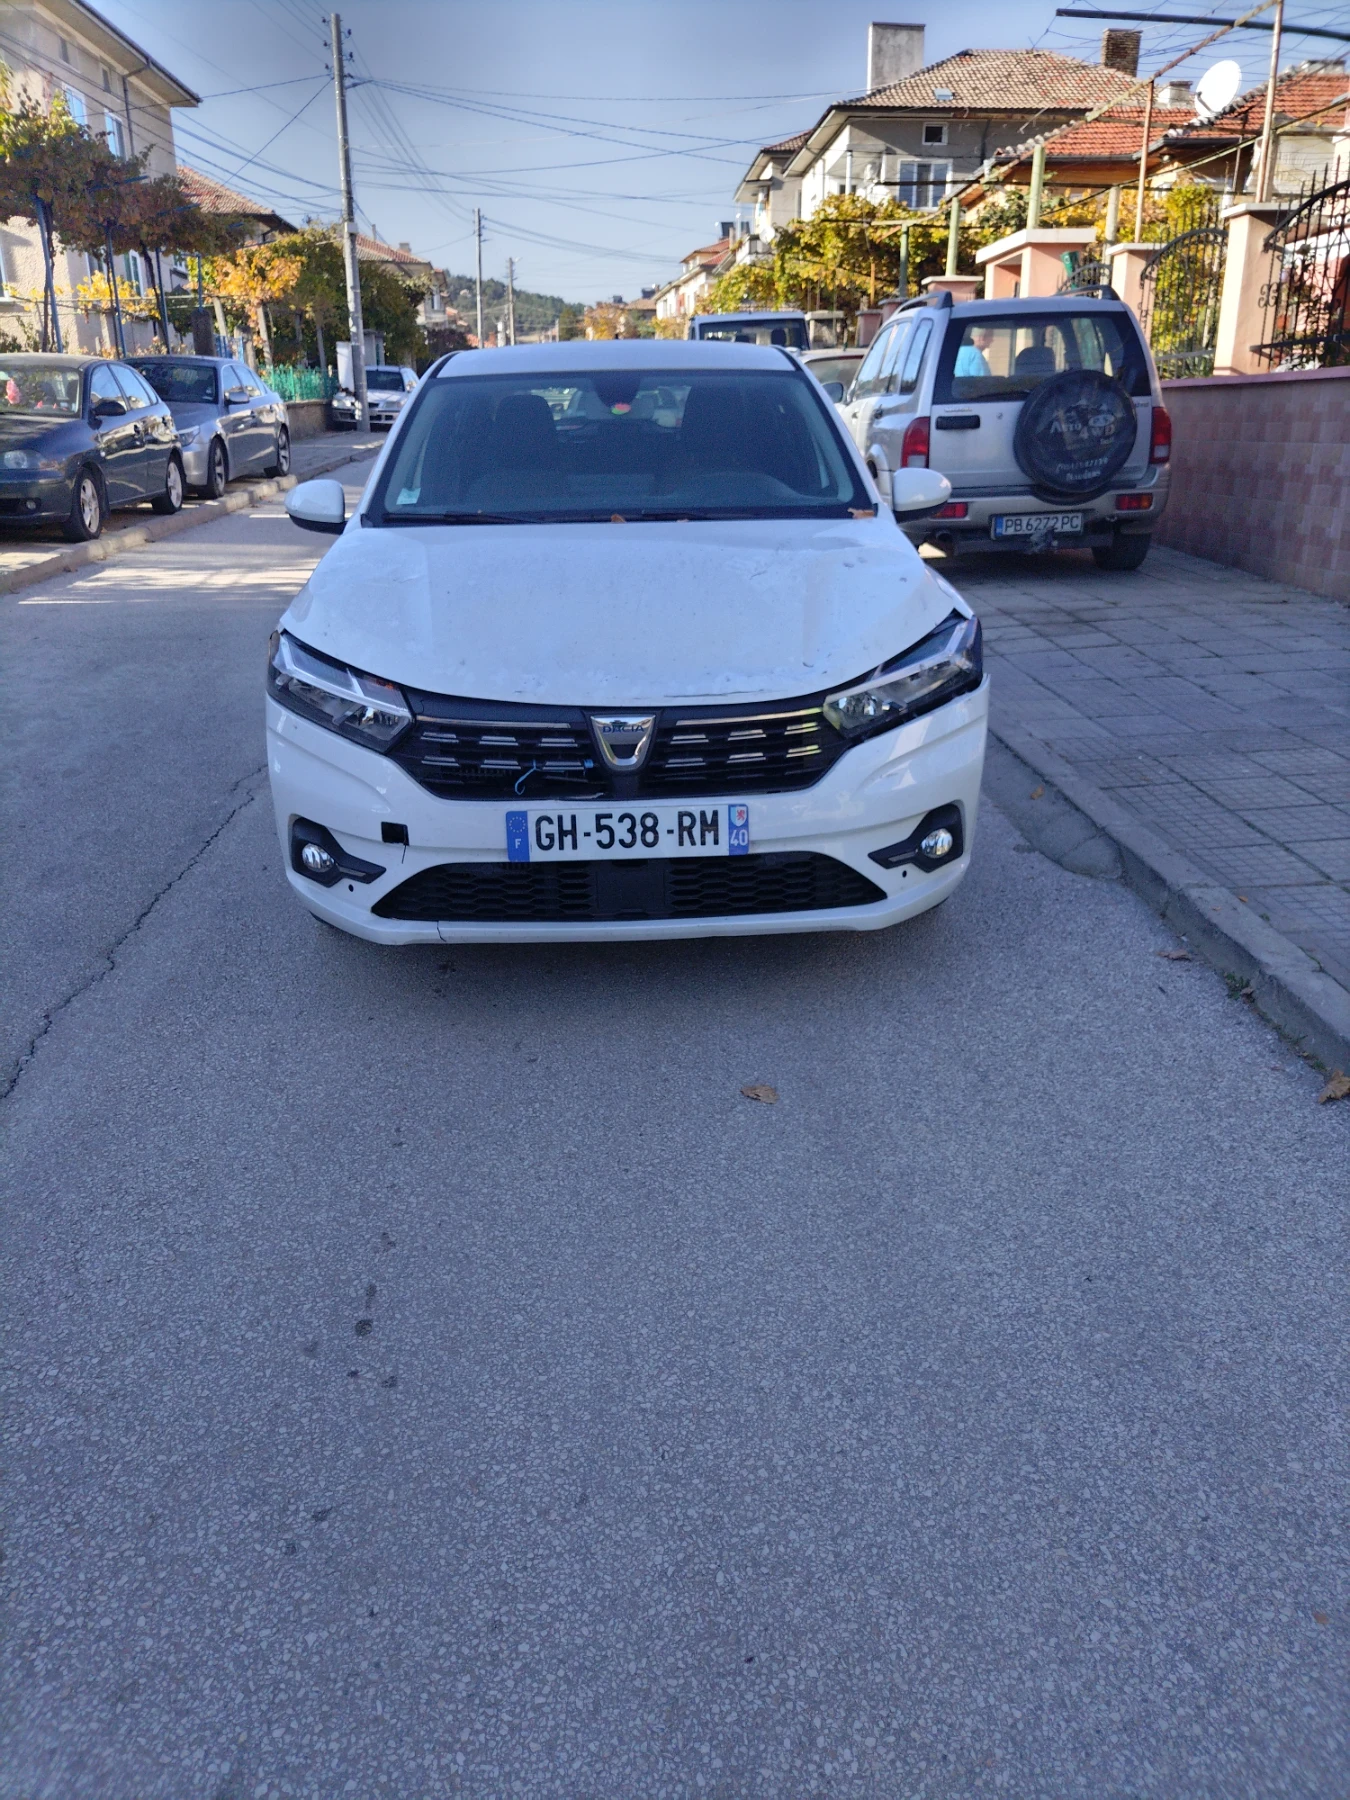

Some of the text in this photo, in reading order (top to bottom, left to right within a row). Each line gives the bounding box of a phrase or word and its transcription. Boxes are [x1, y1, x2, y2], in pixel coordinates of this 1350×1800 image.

[602, 725, 645, 733] DACIA
[535, 809, 720, 851] GH-538-RM
[514, 838, 522, 849] F
[730, 829, 748, 847] 40
